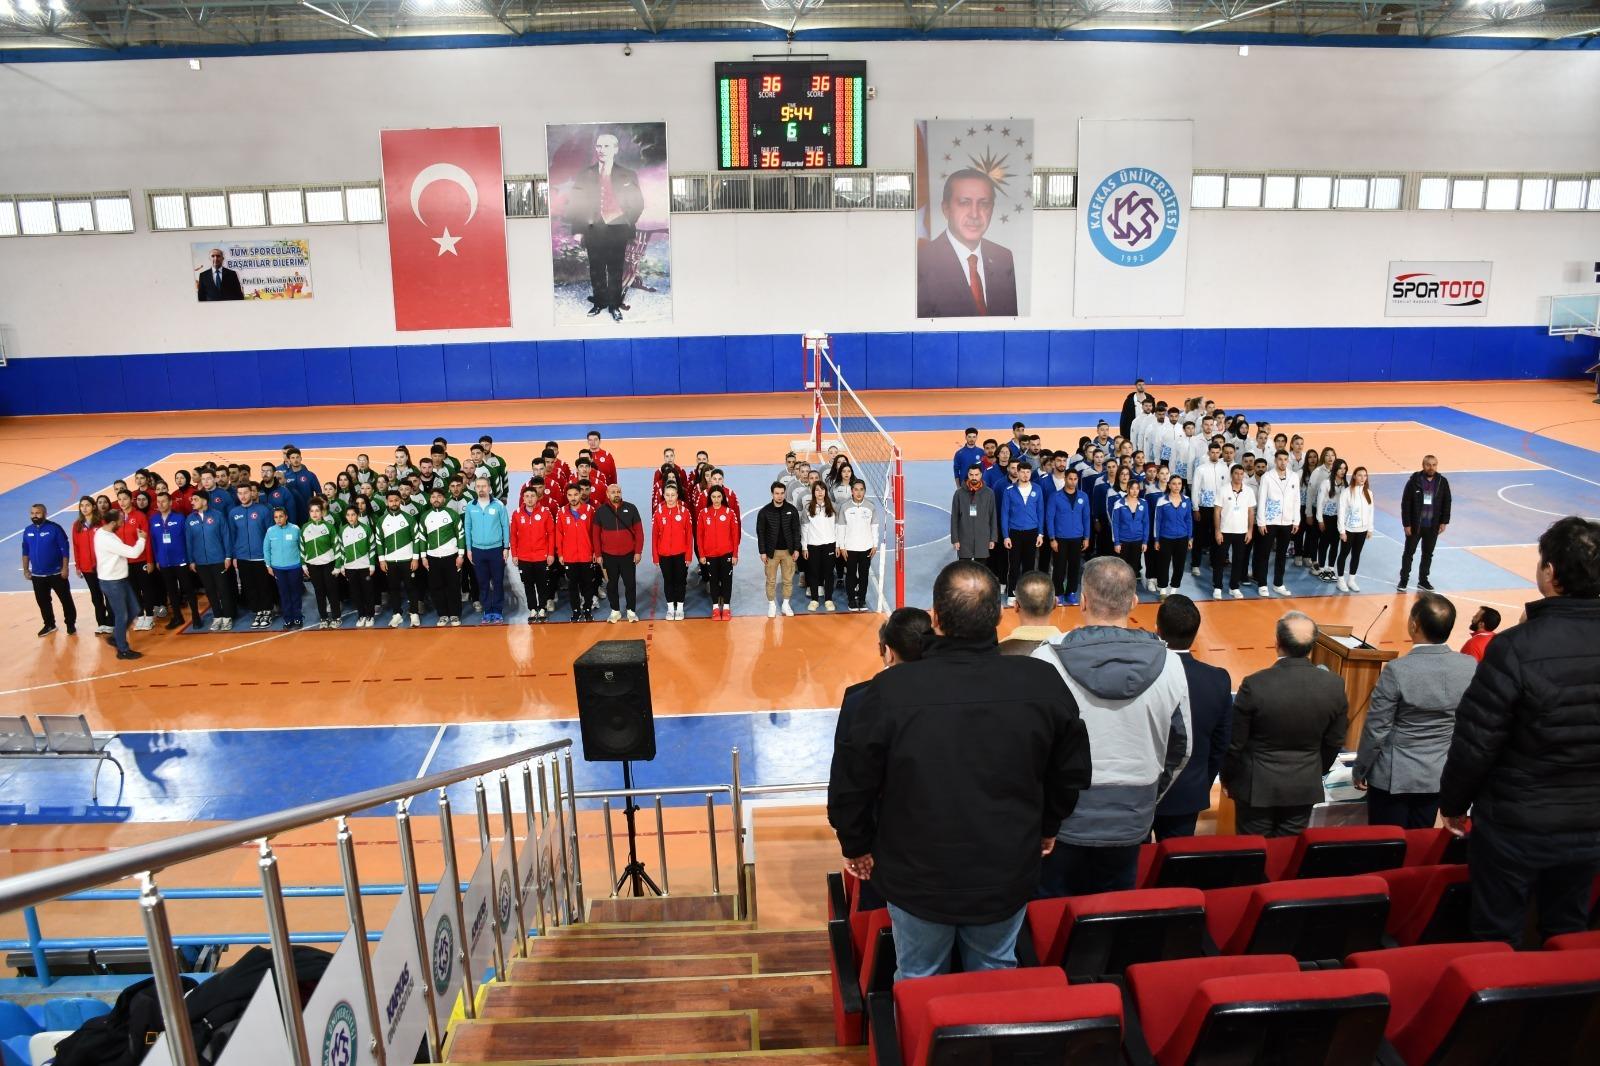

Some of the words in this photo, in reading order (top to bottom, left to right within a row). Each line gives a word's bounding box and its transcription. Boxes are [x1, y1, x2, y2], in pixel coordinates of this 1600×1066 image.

[762, 76, 782, 92] 36
[811, 75, 830, 92] 36
[781, 106, 813, 121] 9:44
[786, 122, 797, 138] 6
[761, 152, 780, 167] 36
[805, 151, 824, 167] 36
[1090, 178, 1117, 229] KAFKAS
[1119, 168, 1178, 230] ÜNİVERSİTESİ
[250, 246, 301, 256] SPORCULARA
[1121, 254, 1145, 263] 1992
[227, 259, 271, 270] BAŞARILAR
